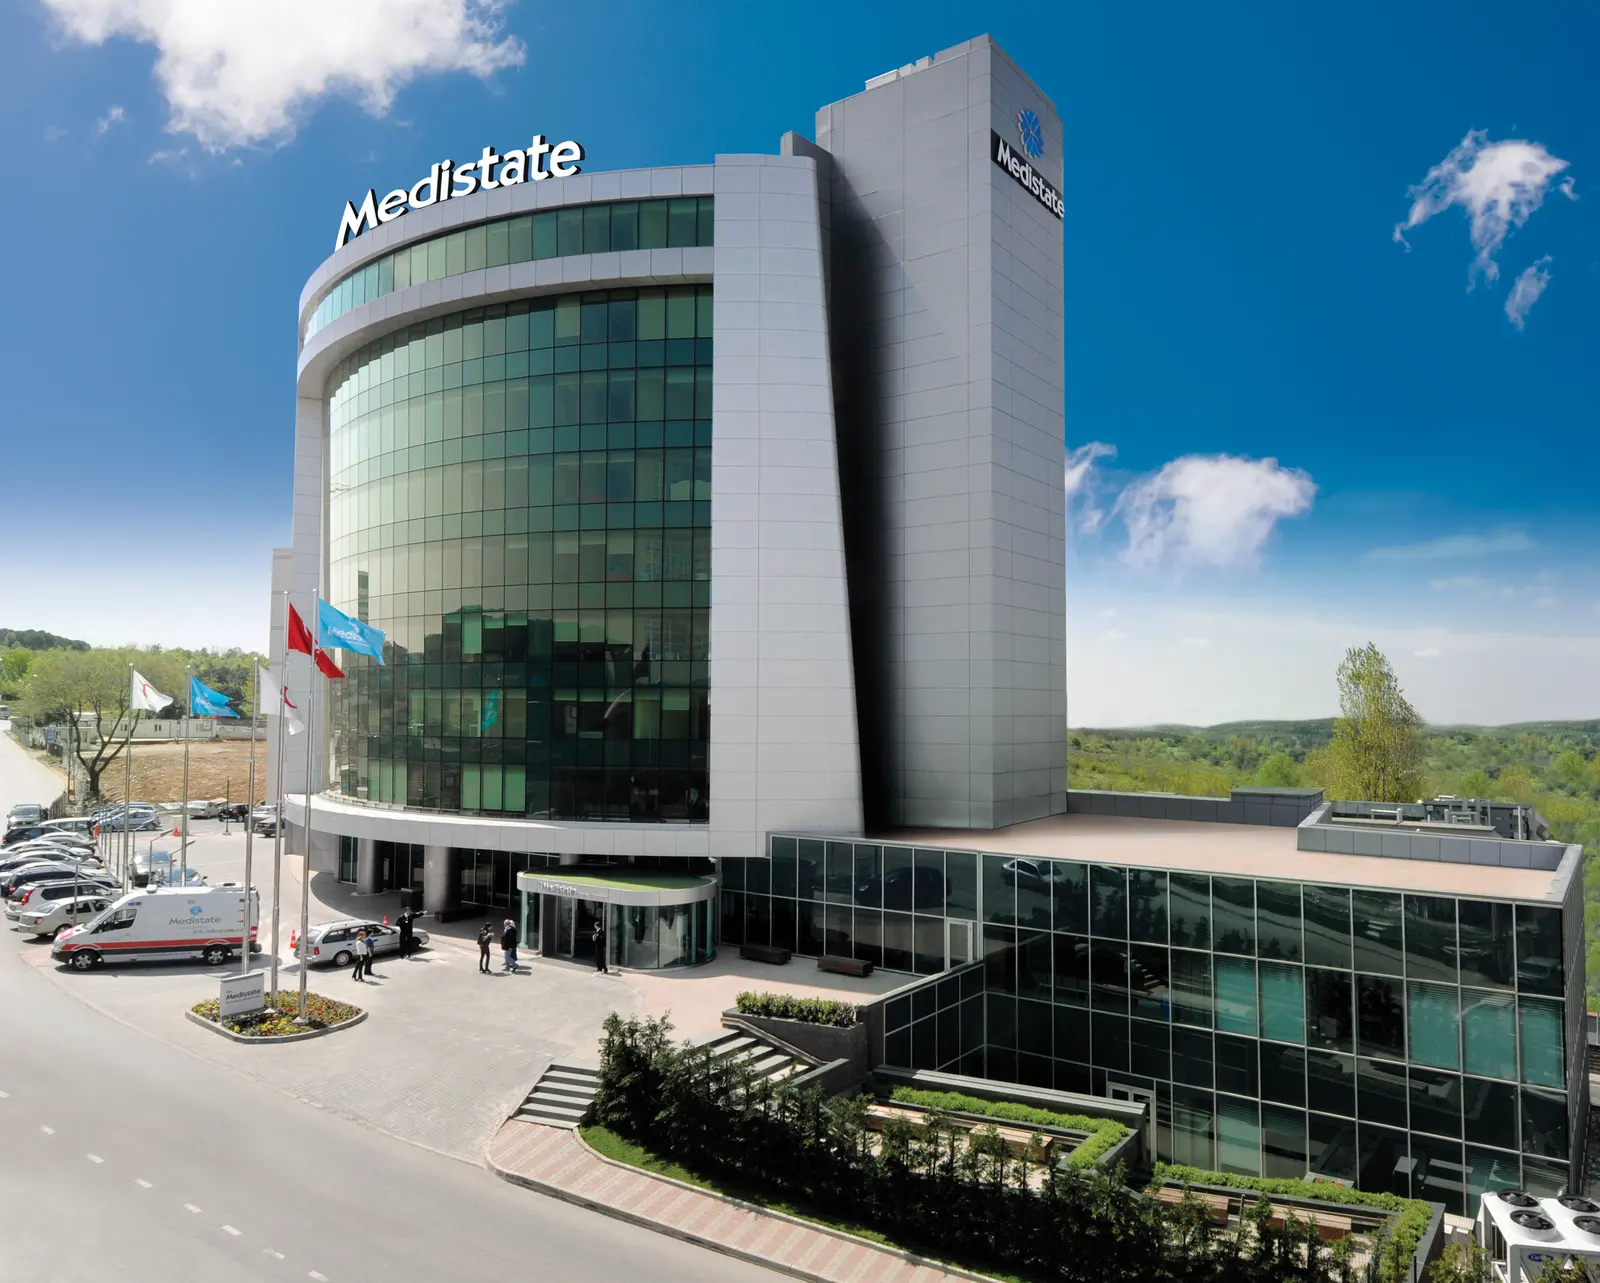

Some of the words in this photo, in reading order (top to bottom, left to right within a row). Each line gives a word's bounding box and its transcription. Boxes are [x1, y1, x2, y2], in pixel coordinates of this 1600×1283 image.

[334, 134, 585, 252] Medistate
[997, 137, 1064, 219] Medistate
[168, 916, 222, 925] Medistate
[226, 989, 261, 1000] Medistate
